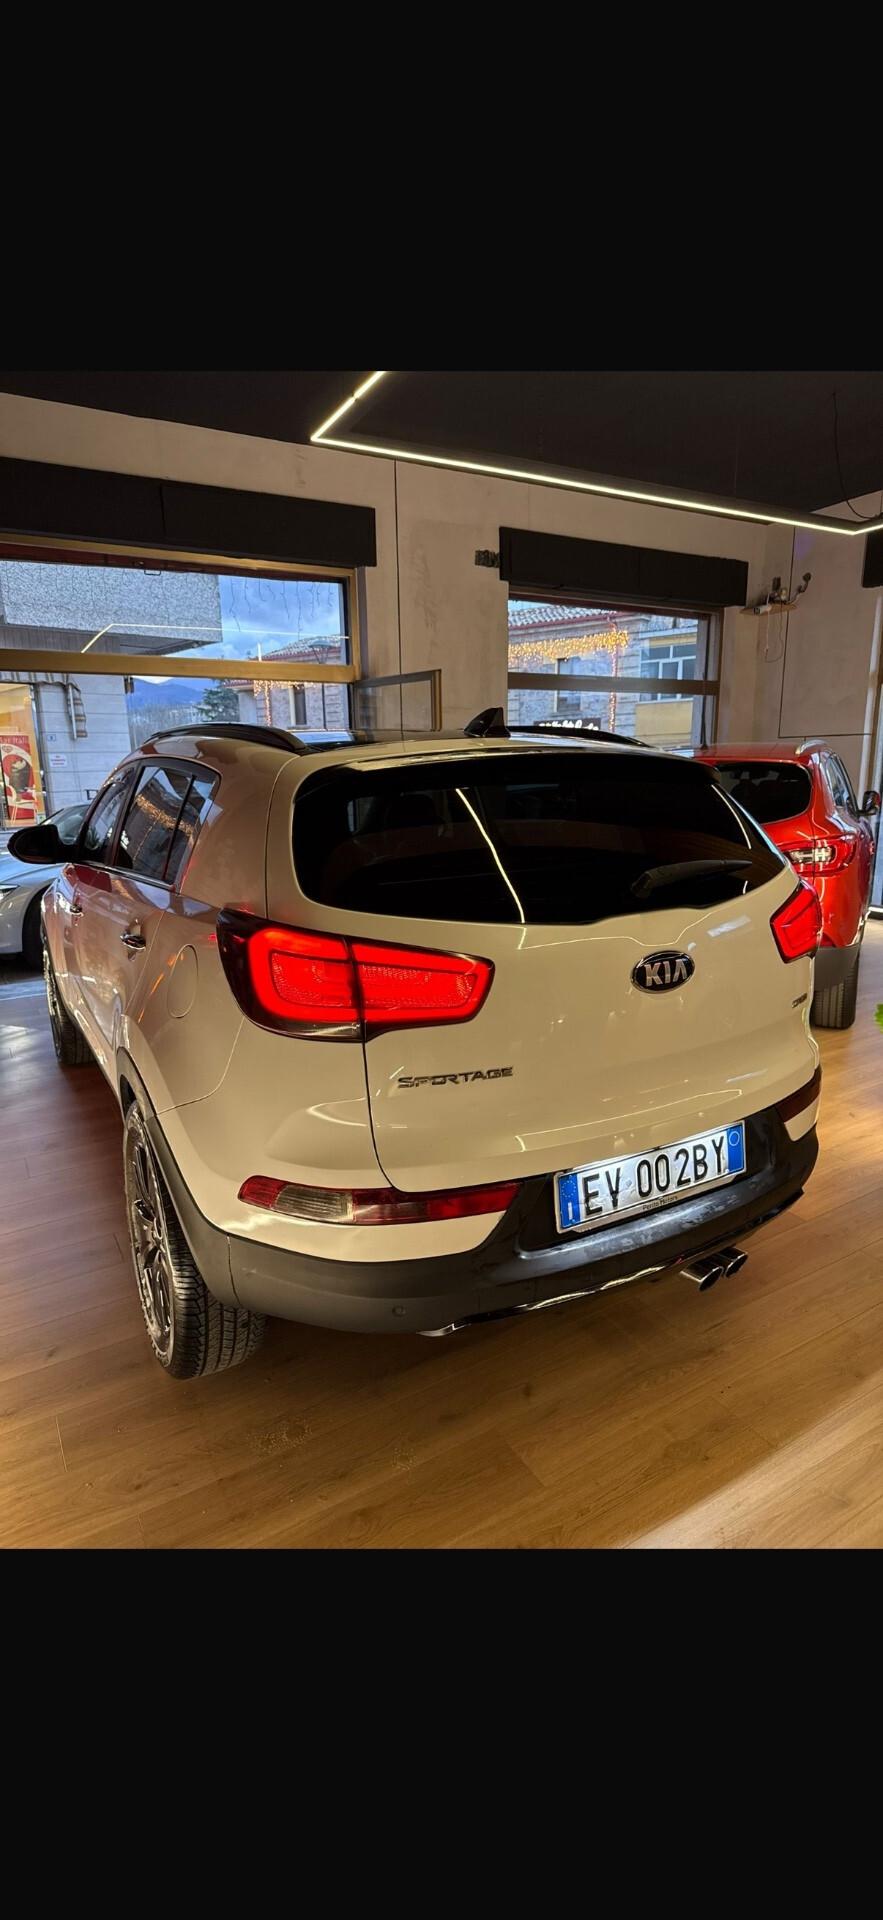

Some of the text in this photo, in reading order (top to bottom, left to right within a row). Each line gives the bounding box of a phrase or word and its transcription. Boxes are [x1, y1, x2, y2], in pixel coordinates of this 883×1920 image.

[644, 958, 687, 987] KIA
[397, 1066, 513, 1088] SPORTAGE
[582, 1168, 621, 1216] EV
